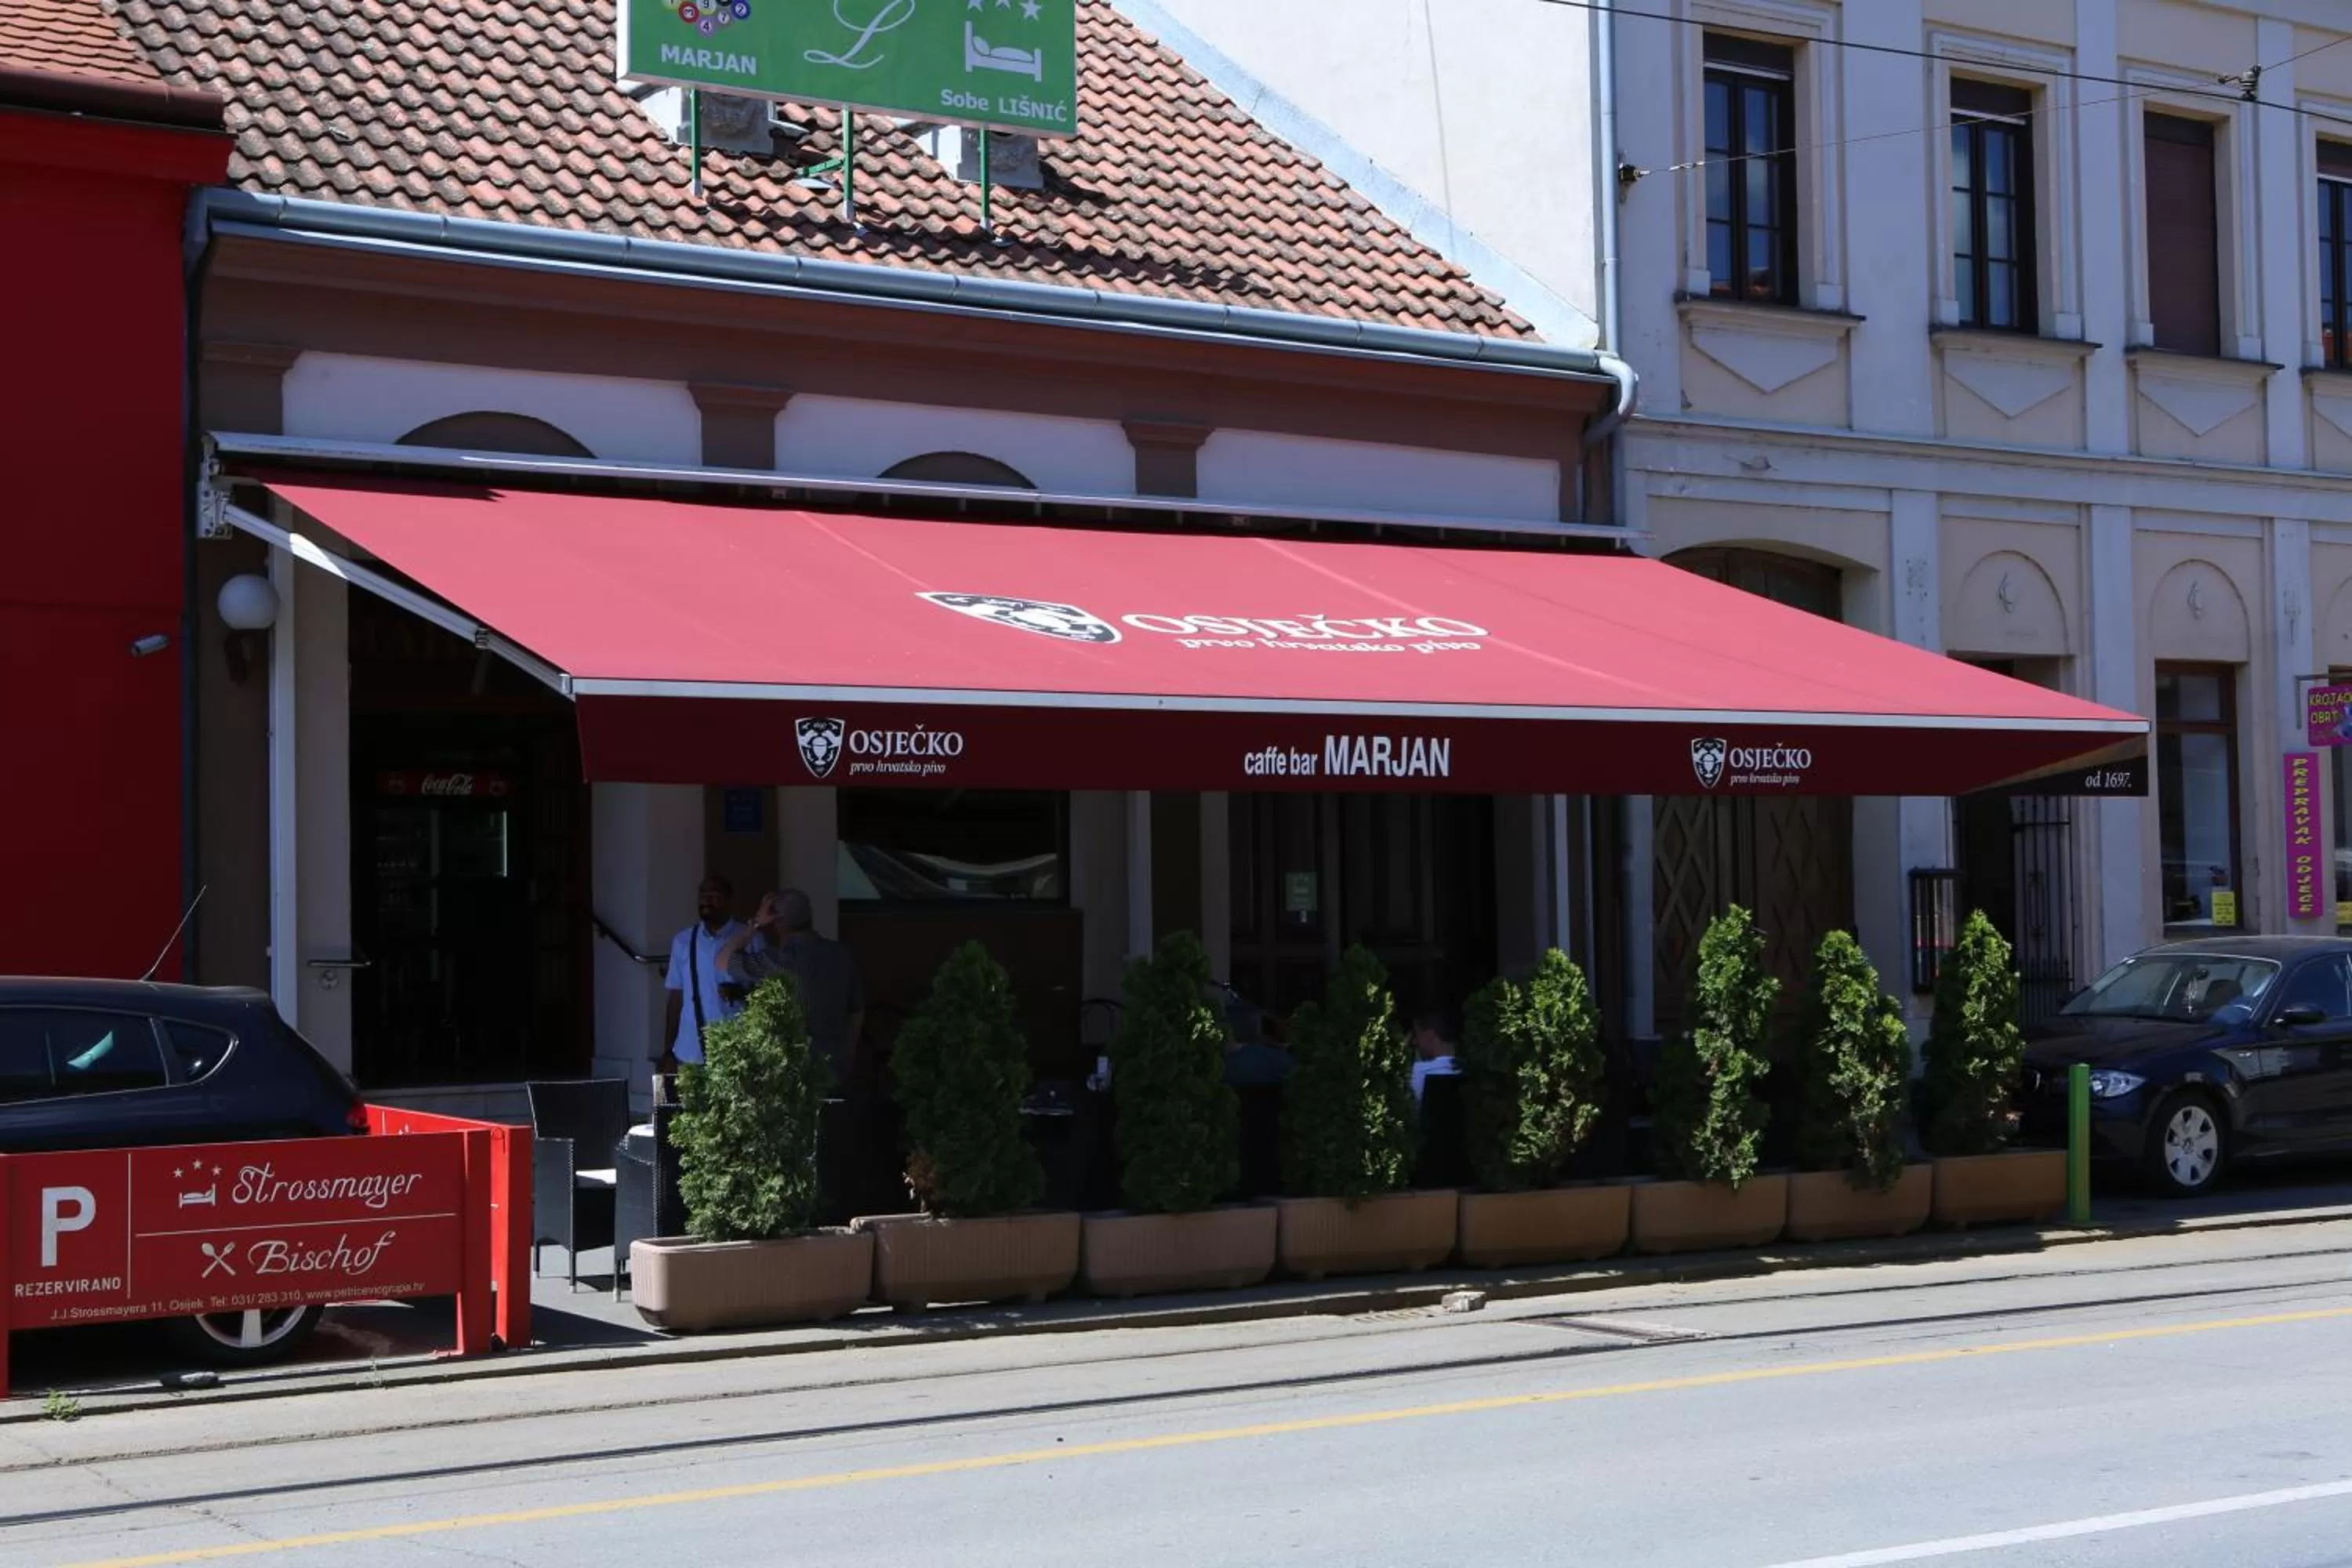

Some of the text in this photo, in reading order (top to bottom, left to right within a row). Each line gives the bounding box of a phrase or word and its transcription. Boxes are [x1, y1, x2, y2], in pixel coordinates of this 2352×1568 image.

[661, 42, 757, 75] MARJAN
[940, 88, 1068, 123] Sobe LIŠNIĆ
[1121, 614, 1490, 639] OSJEČKO
[1176, 638, 1255, 650] prvo
[849, 724, 964, 757] OSJEČKO
[1244, 734, 1450, 777] caffe bar MARJAN
[1730, 742, 1812, 771] OSJEČKO
[849, 760, 946, 776] prvo hrvatsko pivo
[2085, 771, 2101, 788] od
[231, 1161, 423, 1210] Strossmayer
[41, 1185, 96, 1268] P
[247, 1230, 396, 1276] Bischof
[14, 1276, 122, 1298] REZERVIRANO
